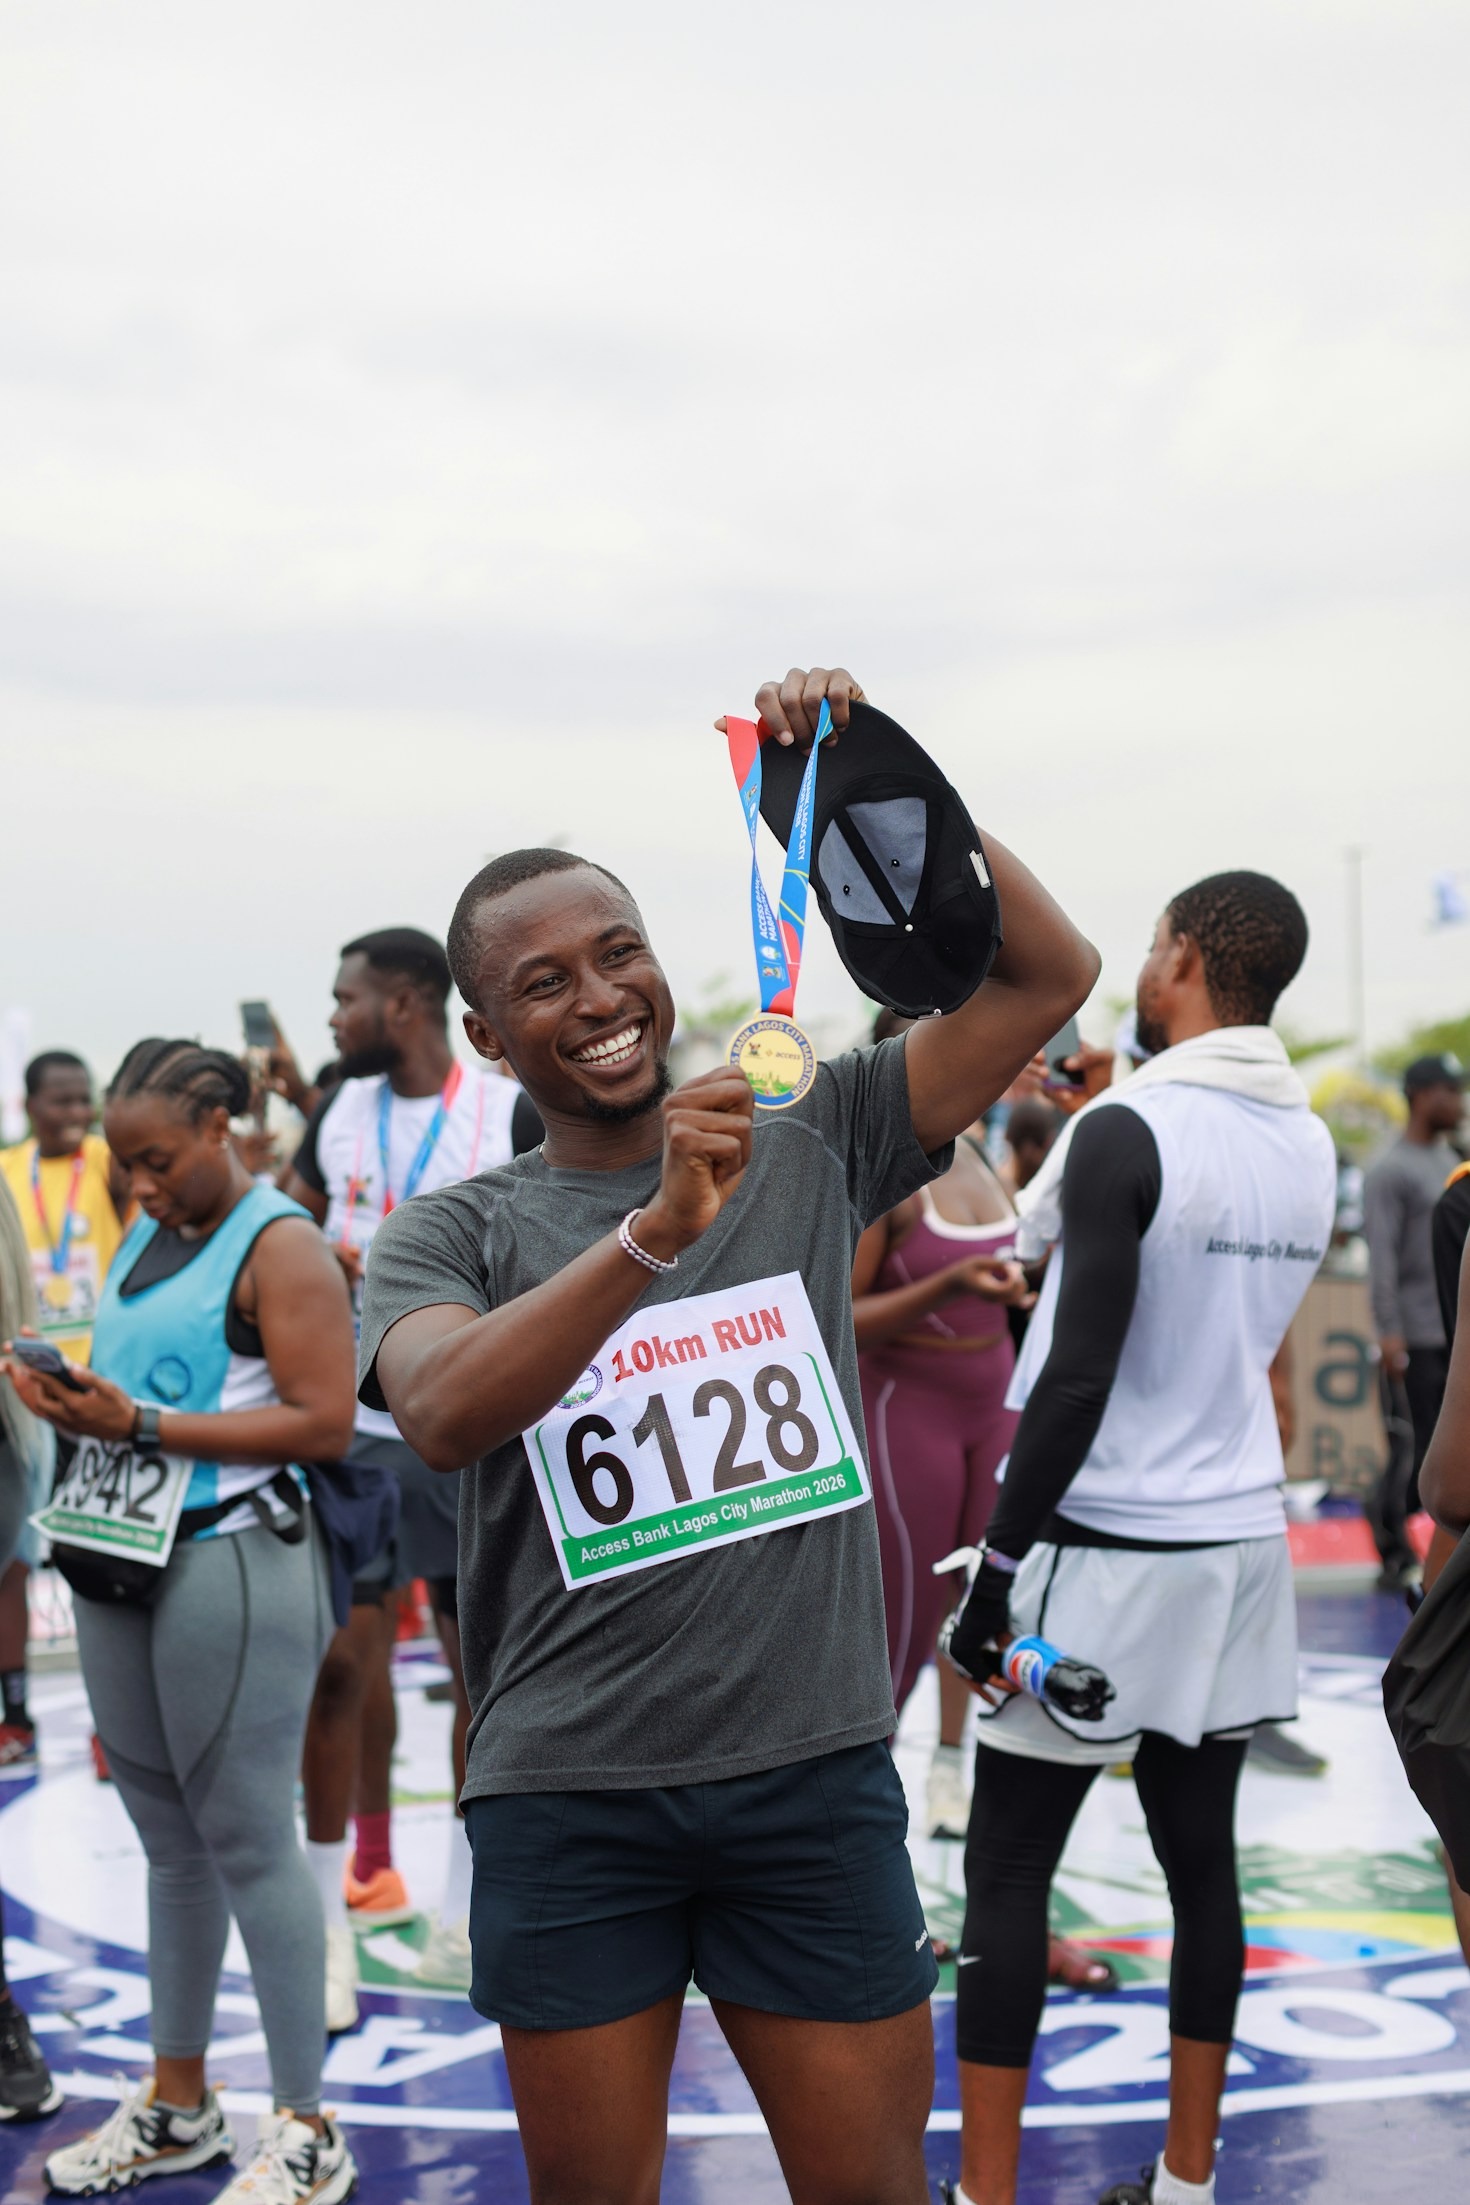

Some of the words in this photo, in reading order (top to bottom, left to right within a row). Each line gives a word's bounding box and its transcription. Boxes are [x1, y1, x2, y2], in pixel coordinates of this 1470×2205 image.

[800, 806, 809, 839] LAGOS
[798, 840, 806, 861] CITY
[757, 902, 769, 939] ACCESS
[733, 1028, 753, 1054] BANK
[752, 1020, 785, 1032] LAGOS
[785, 1026, 804, 1044] CITY
[775, 1051, 801, 1060] access
[791, 1043, 813, 1097] MARATHON
[611, 1331, 708, 1383] 10km
[711, 1306, 787, 1353] RUN
[565, 1363, 820, 1527] 6128
[580, 1536, 631, 1564] Access
[633, 1521, 672, 1548] Bank
[673, 1509, 719, 1536] Lagos
[720, 1500, 749, 1523] City
[751, 1484, 812, 1514] Marathon
[813, 1473, 847, 1498] 2026
